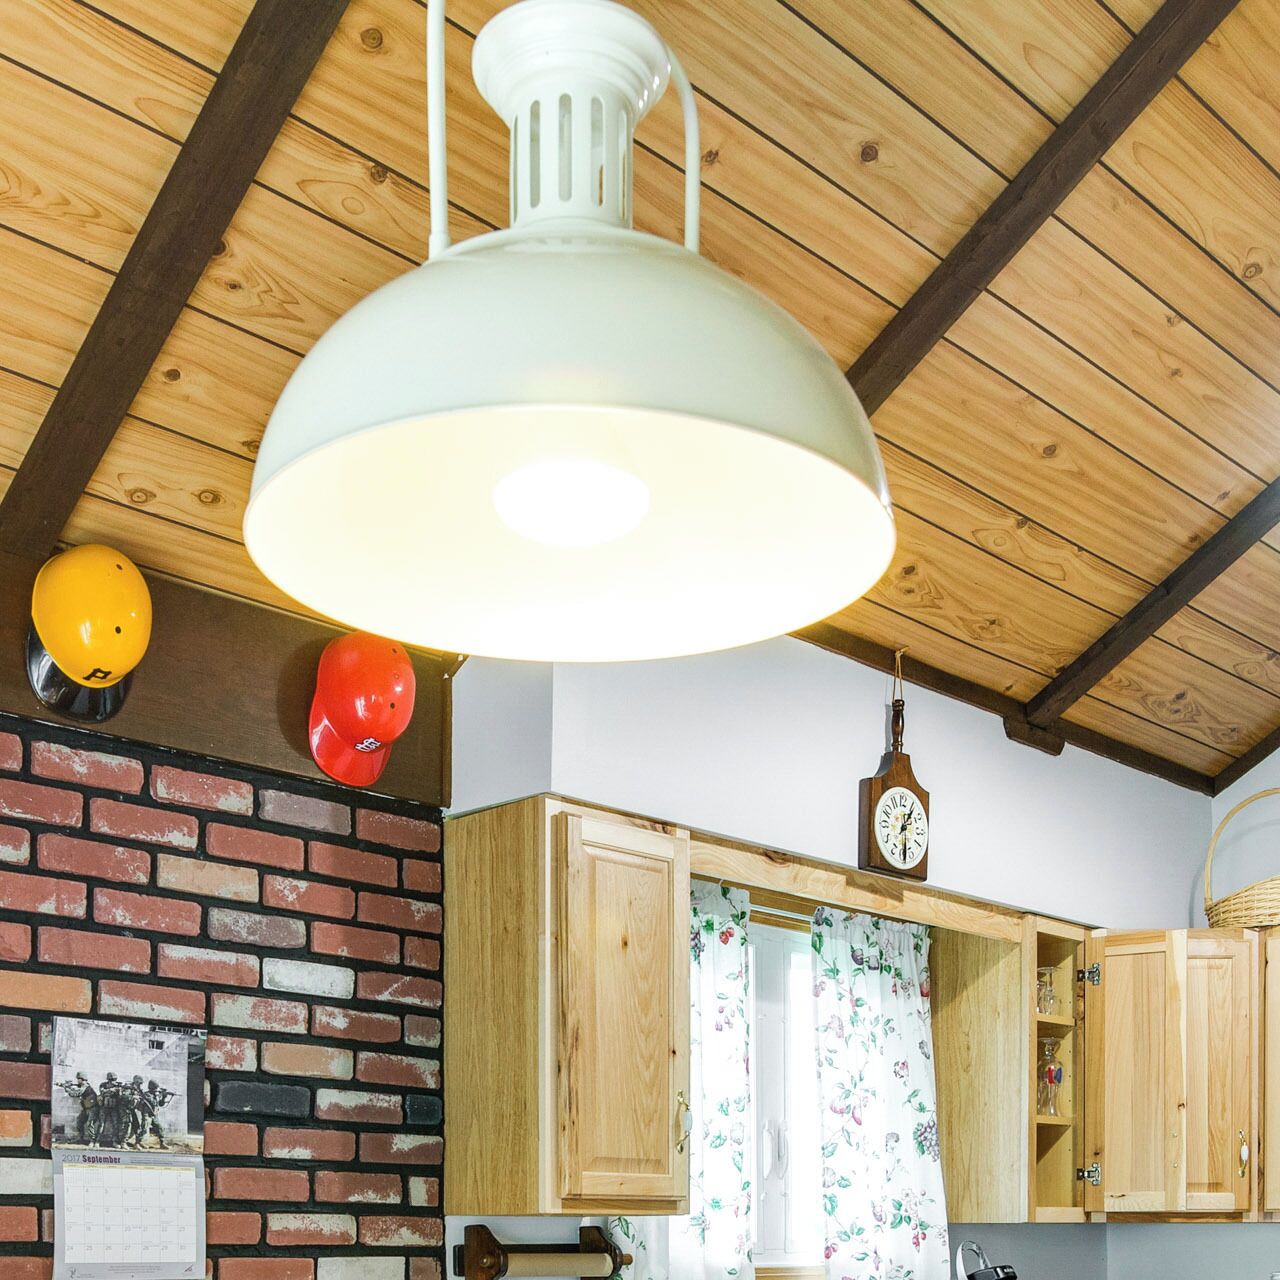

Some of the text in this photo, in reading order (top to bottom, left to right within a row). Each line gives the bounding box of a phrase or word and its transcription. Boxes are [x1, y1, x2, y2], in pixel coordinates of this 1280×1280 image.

[82, 667, 112, 682] P
[62, 1154, 80, 1162] 2017
[82, 1155, 120, 1164] September
